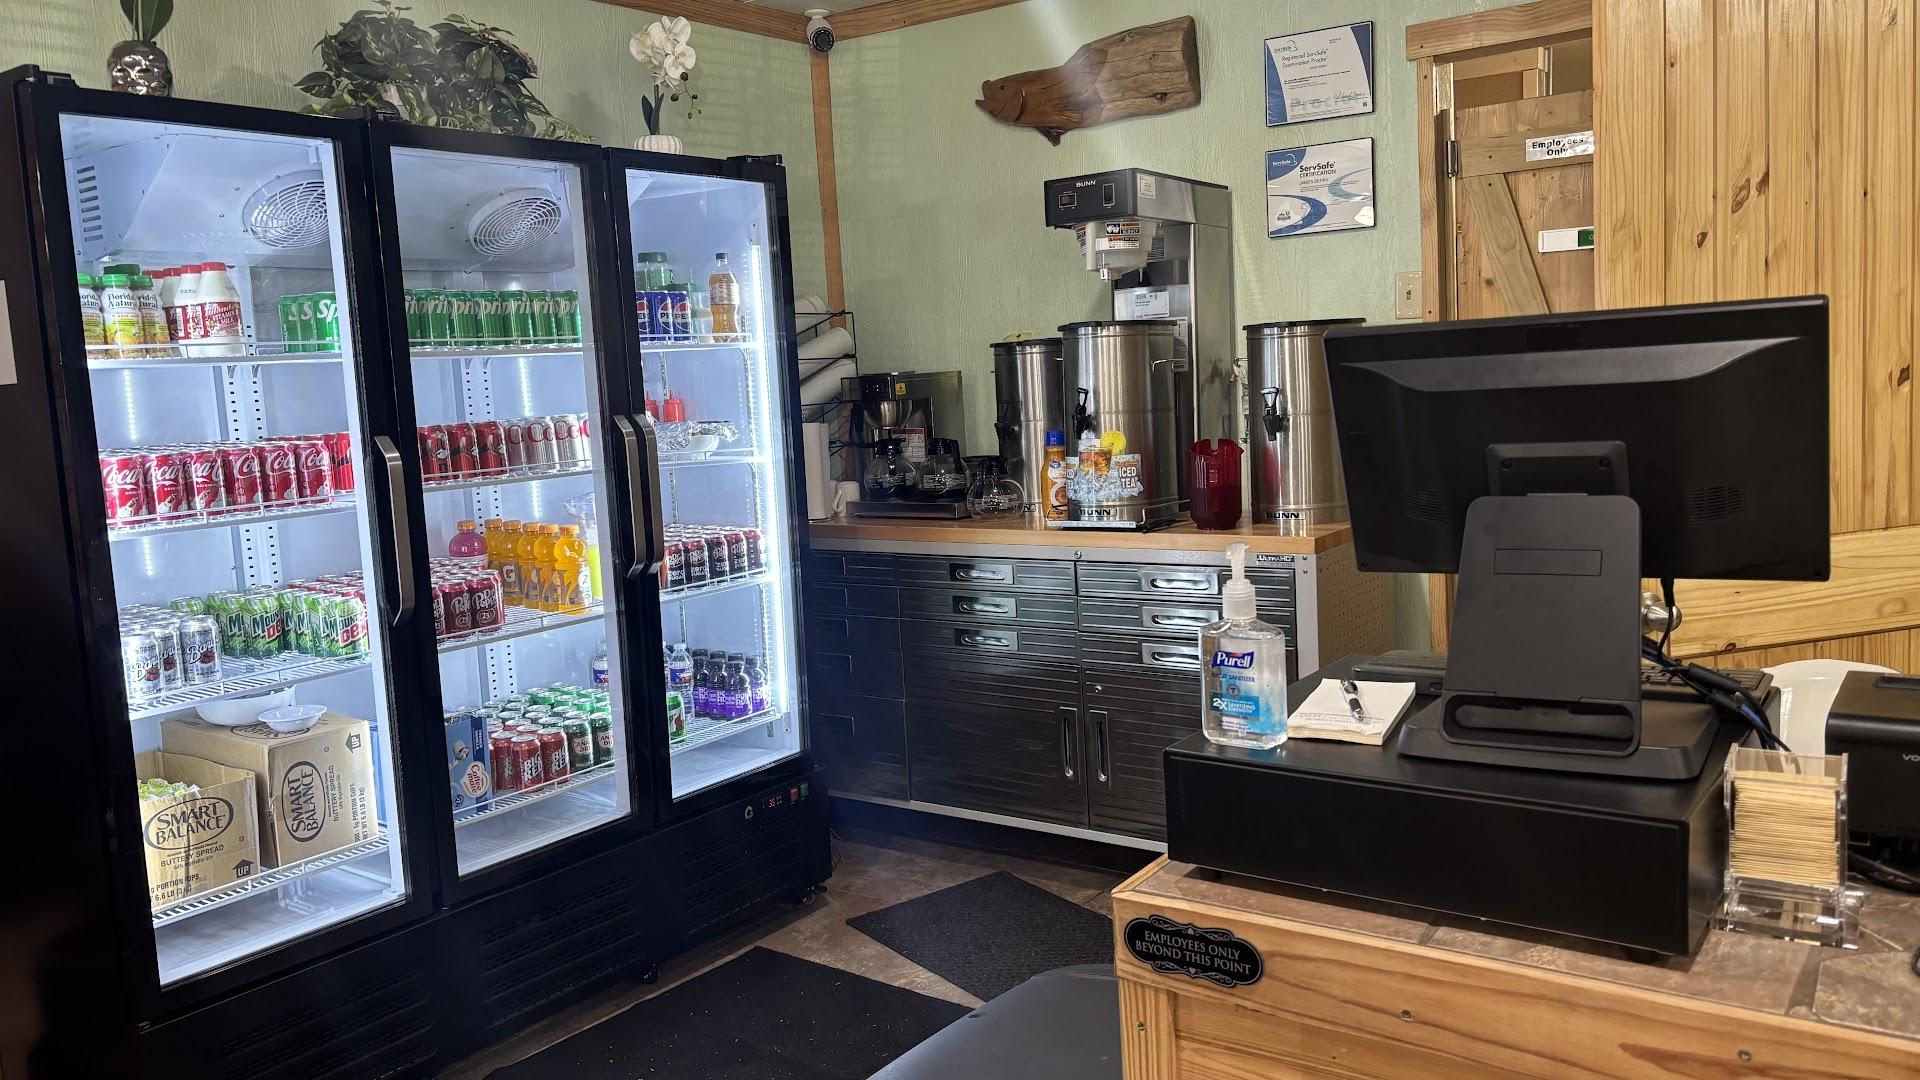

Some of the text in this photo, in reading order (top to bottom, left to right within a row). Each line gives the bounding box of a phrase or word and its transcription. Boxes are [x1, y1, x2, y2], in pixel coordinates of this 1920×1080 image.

[1532, 138, 1584, 150] Employees
[1300, 162, 1334, 172] ServSafe
[1300, 170, 1336, 178] CERTIFICATION
[1119, 466, 1136, 478] ICED
[1120, 478, 1136, 489] TEA
[1216, 652, 1250, 668] Purell
[1229, 674, 1255, 682] SANITIZER
[1212, 698, 1228, 710] 2X
[352, 736, 360, 748] UP
[524, 752, 542, 770] BIG
[470, 764, 482, 790] Coffee
[524, 762, 542, 784] RED
[467, 774, 478, 794] mate
[288, 777, 306, 834] SMART
[301, 769, 319, 832] BALANCE
[157, 801, 220, 830] SMART
[156, 814, 226, 845] BALANCE
[196, 844, 224, 858] SPREAD
[238, 866, 249, 876] UP
[156, 878, 184, 892] PORTION
[1144, 930, 1240, 960] EMPLOYEES ONLY
[1136, 940, 1251, 975] BEYOND THIS POINT
